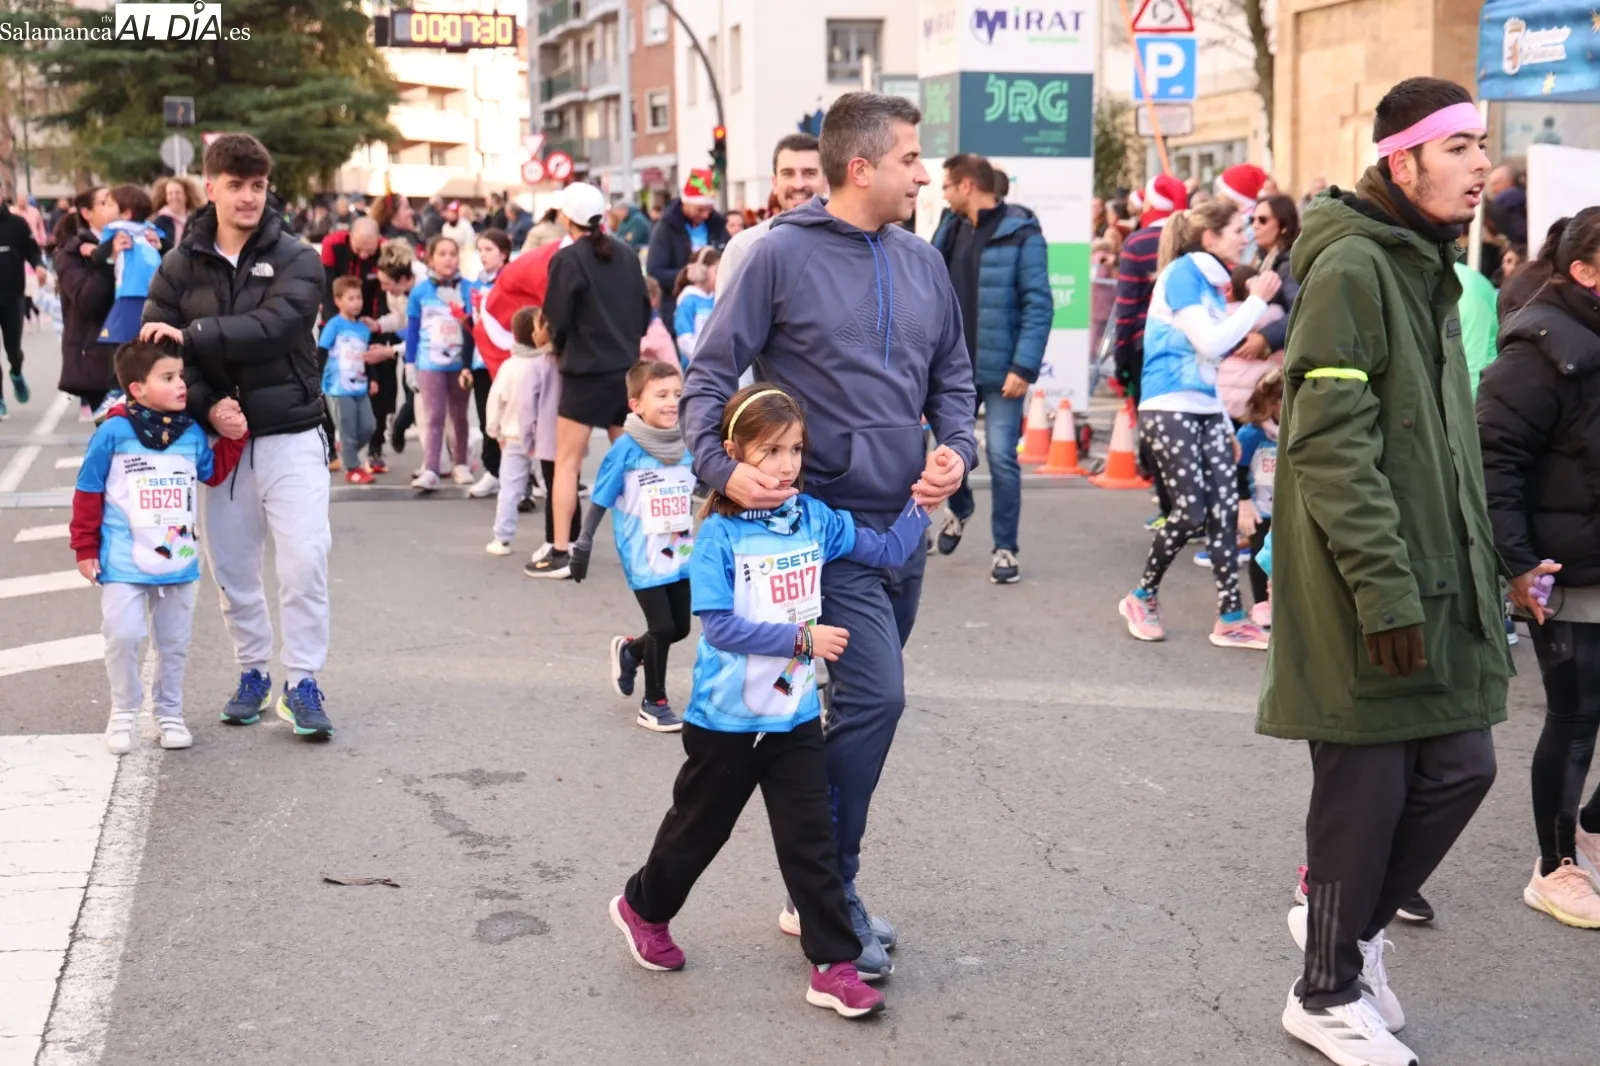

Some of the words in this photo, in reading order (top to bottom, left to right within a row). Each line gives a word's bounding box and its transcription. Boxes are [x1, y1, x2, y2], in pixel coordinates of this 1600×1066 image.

[1145, 41, 1186, 97] P
[985, 72, 1069, 123] JRG
[149, 477, 187, 487] SETEL
[139, 488, 182, 509] 6629
[650, 495, 688, 518] 6638
[769, 565, 818, 605] 6617
